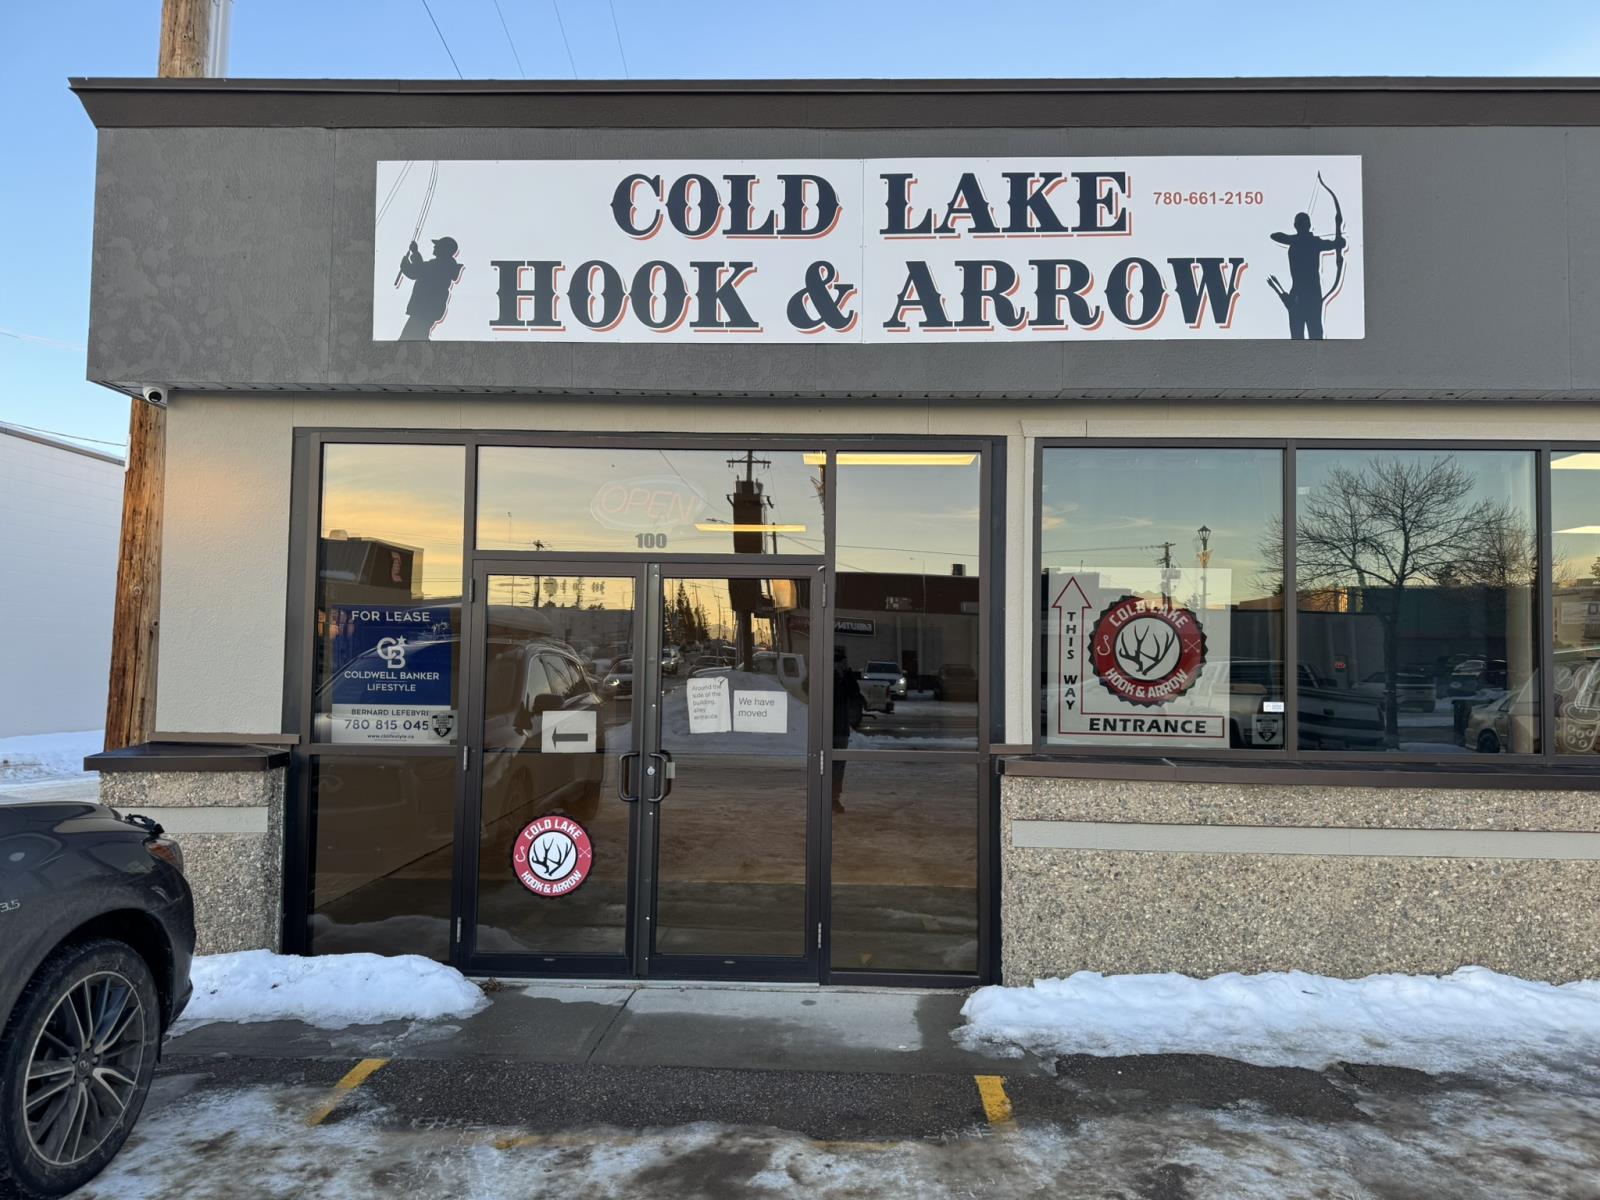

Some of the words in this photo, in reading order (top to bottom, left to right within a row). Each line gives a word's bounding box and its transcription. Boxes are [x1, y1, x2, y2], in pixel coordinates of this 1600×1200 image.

[610, 173, 843, 240] COLD
[879, 171, 1132, 239] LAKE
[1153, 191, 1263, 205] 780-661-2150
[489, 260, 763, 333] HOOK
[786, 260, 857, 333] &
[883, 257, 1249, 333] ARROW
[600, 485, 698, 521] OPEN
[635, 533, 667, 548] 100
[351, 611, 380, 622] FOR
[386, 611, 431, 622] LEASE
[1109, 601, 1147, 628] COLD
[1151, 601, 1189, 629] LAKE
[1066, 612, 1077, 660] THIS
[344, 671, 397, 680] COLDWELL
[400, 672, 440, 680] BANKER
[1105, 668, 1136, 697] HOOK
[1148, 669, 1189, 698] ARROW
[367, 684, 416, 692] LIFESTYLE
[1064, 675, 1078, 710] WAY
[739, 697, 752, 706] We
[754, 697, 775, 706] have
[351, 708, 389, 716] BERNARD
[738, 708, 768, 718] moved
[344, 720, 370, 730] 780
[376, 720, 398, 730] 815
[1089, 717, 1207, 734] ENTRANCE
[524, 819, 552, 840] COLD
[554, 819, 583, 840] LAKE
[521, 870, 544, 892] HOOK
[543, 884, 551, 894] &
[552, 869, 582, 894] ARROW
